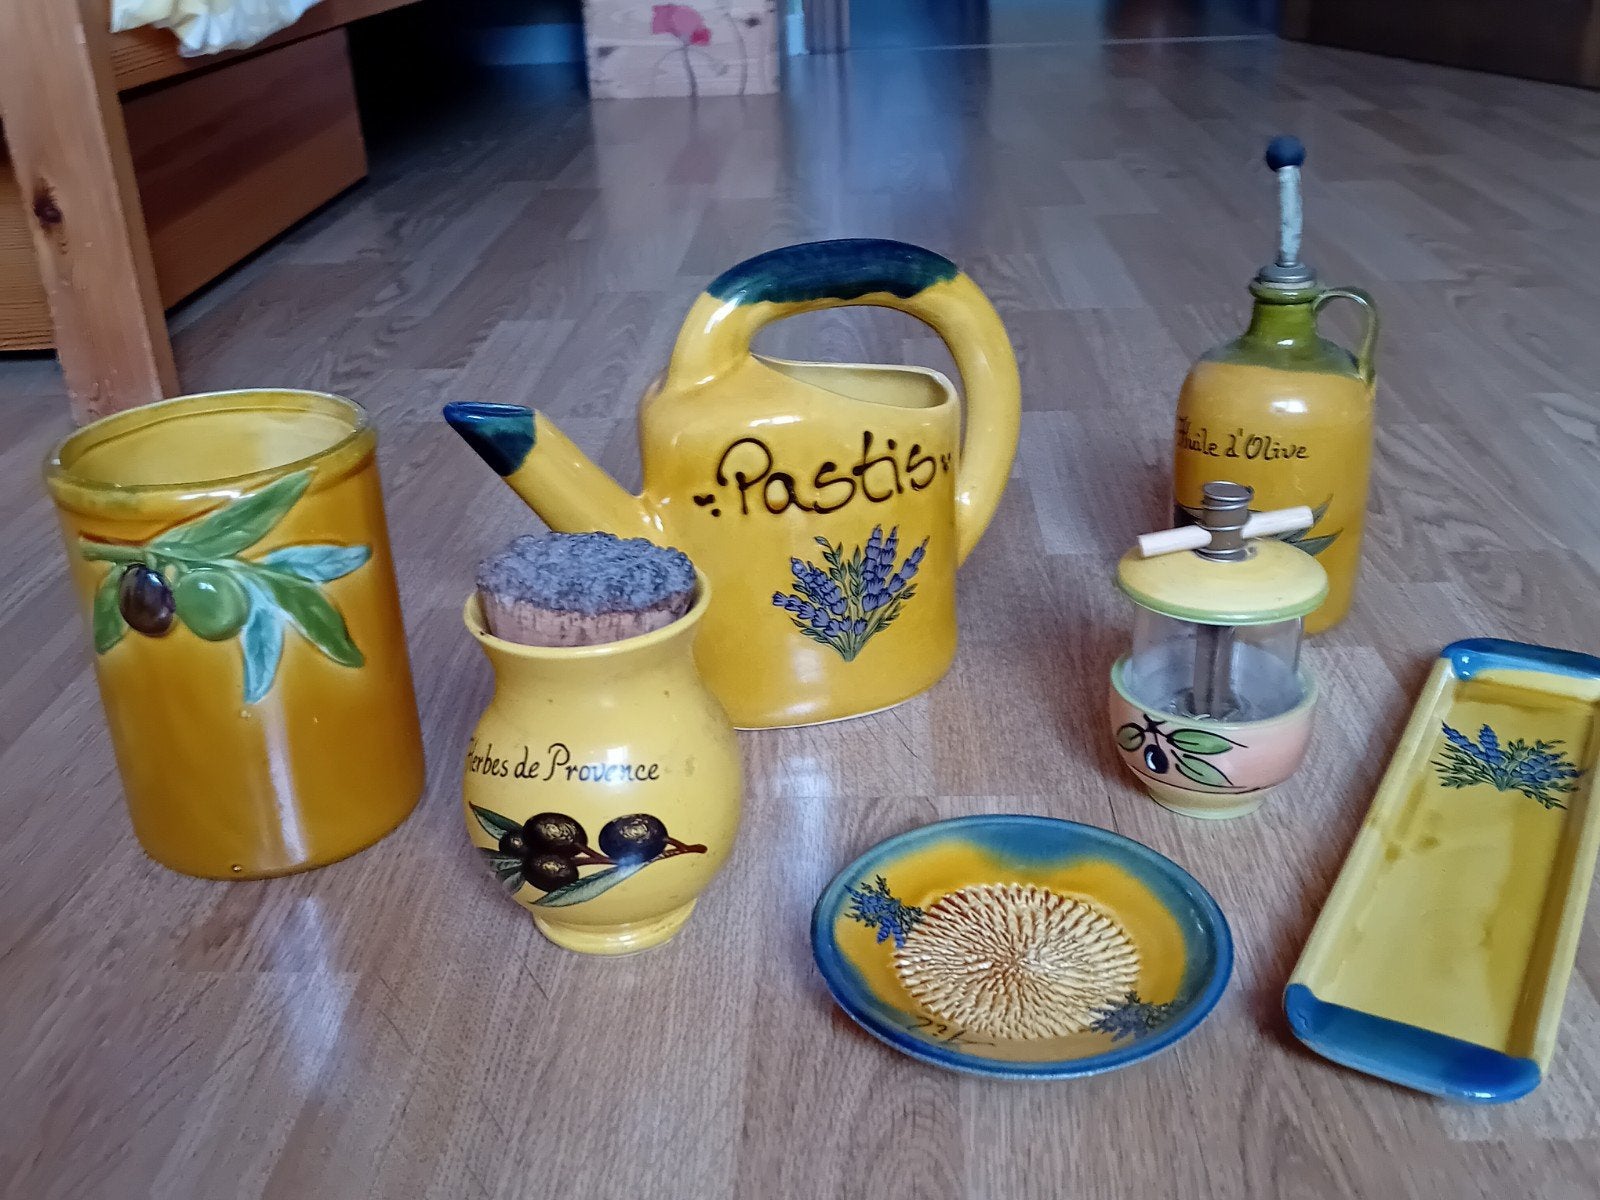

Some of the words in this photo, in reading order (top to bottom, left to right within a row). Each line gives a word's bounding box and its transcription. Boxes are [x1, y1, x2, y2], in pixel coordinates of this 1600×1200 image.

[1225, 428, 1310, 460] d'Olive
[716, 430, 937, 515] Pastis
[514, 745, 541, 779] de
[543, 742, 660, 782] Provence
